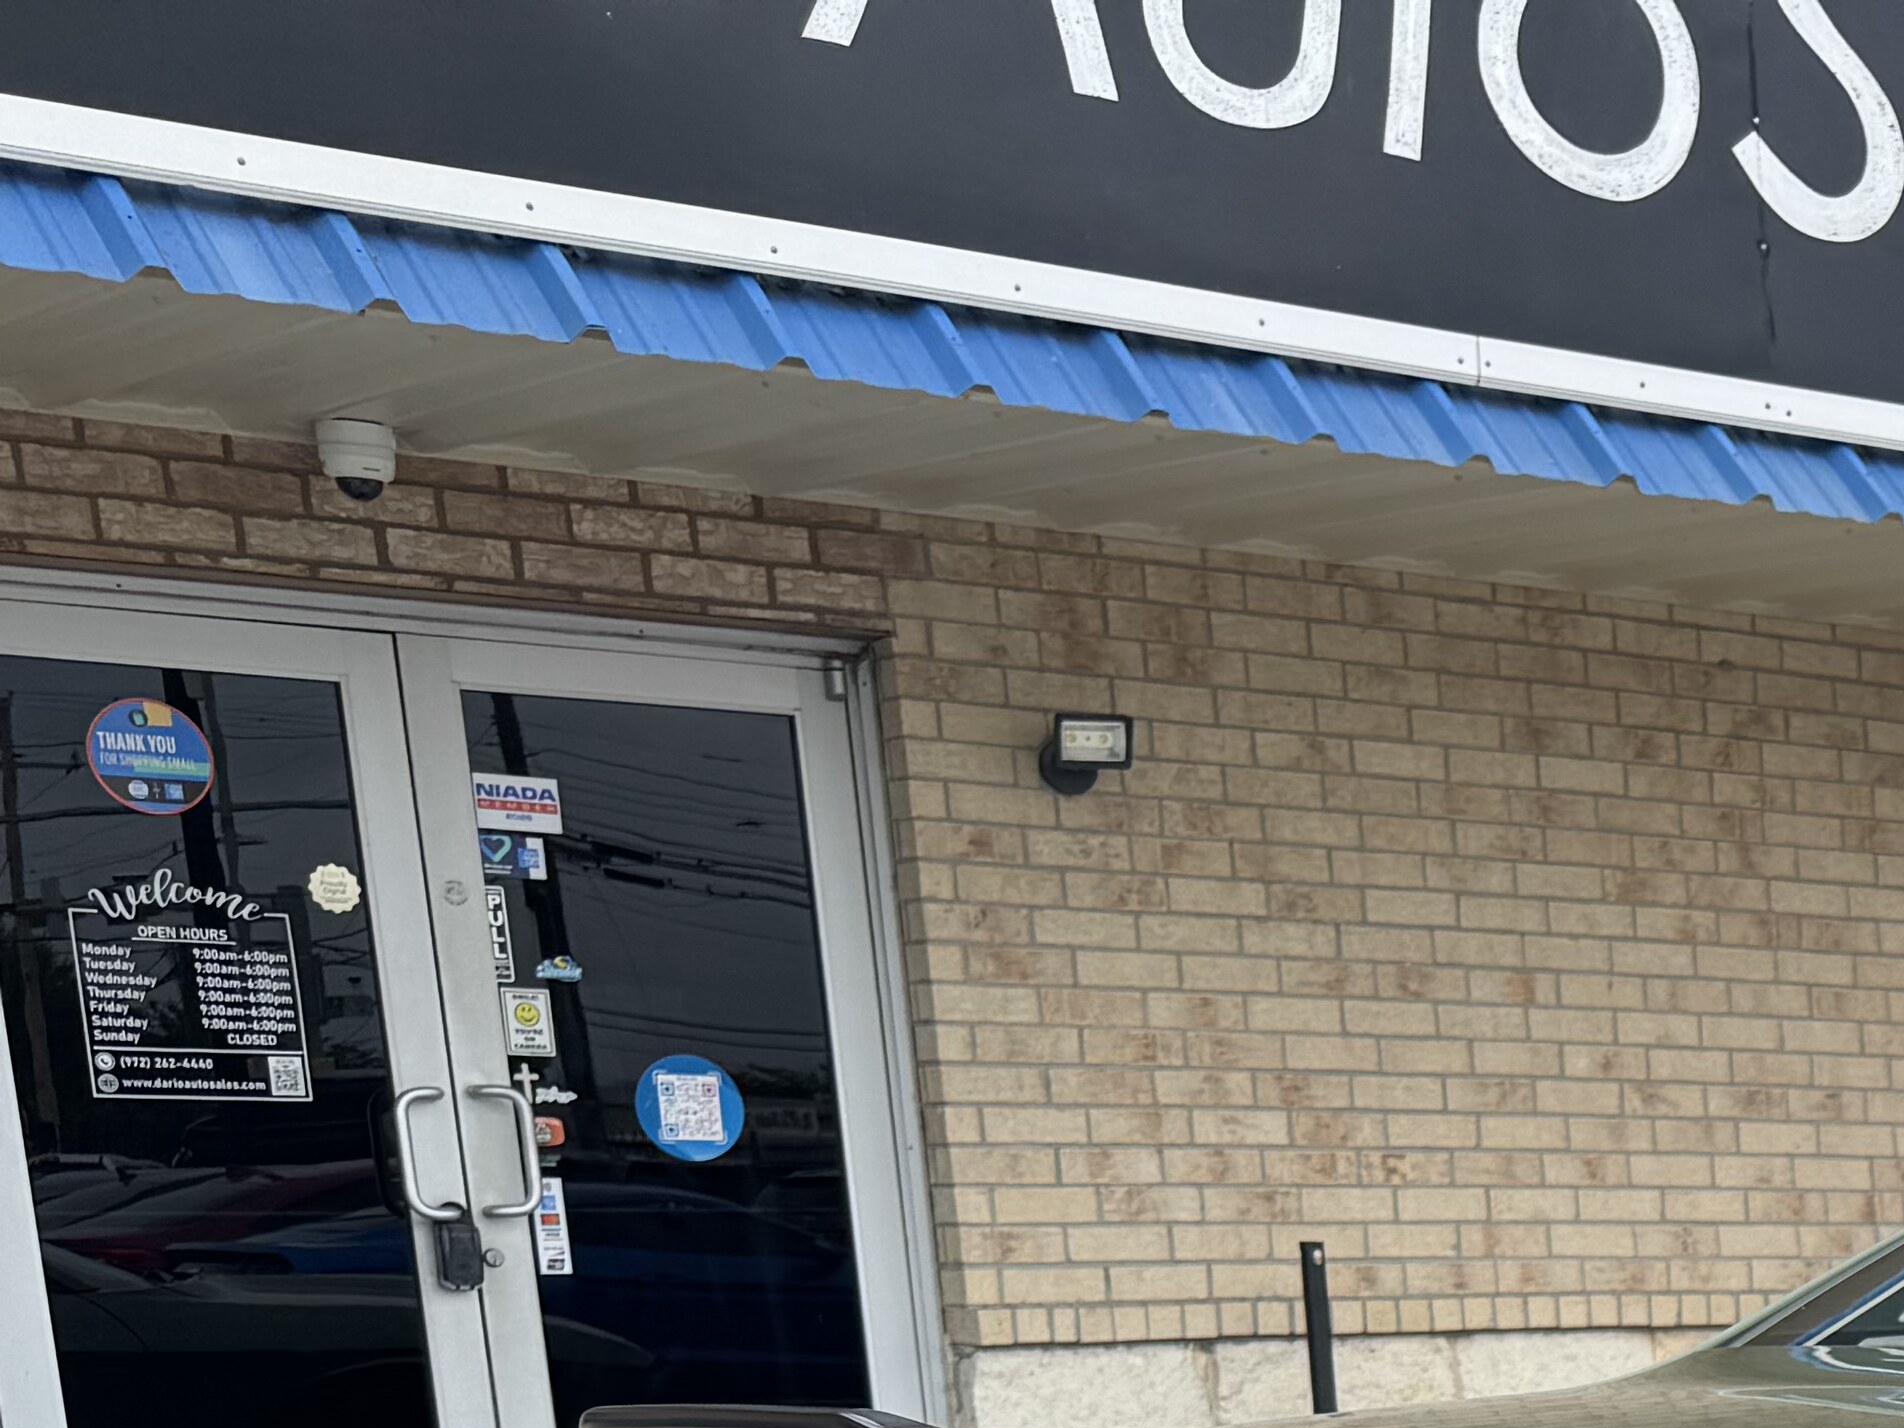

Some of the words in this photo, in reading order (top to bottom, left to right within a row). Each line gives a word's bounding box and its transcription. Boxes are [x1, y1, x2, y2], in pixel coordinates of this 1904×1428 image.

[96, 731, 146, 752] THANK
[147, 734, 177, 754] YOU
[100, 752, 117, 765] FOR
[475, 783, 556, 802] NIADA
[88, 868, 261, 921] Welcome
[137, 925, 176, 939] OPEN
[180, 928, 228, 941] HOURS
[487, 894, 507, 959] PULL
[82, 943, 131, 957] Monday
[83, 957, 135, 972] Tuesday
[86, 972, 157, 988] Wednesday
[87, 986, 146, 1001] Thursday
[90, 1001, 129, 1015] Friday
[92, 1016, 148, 1030] Saturday
[94, 1030, 140, 1044] Sunday
[227, 1033, 278, 1046] CLOSED
